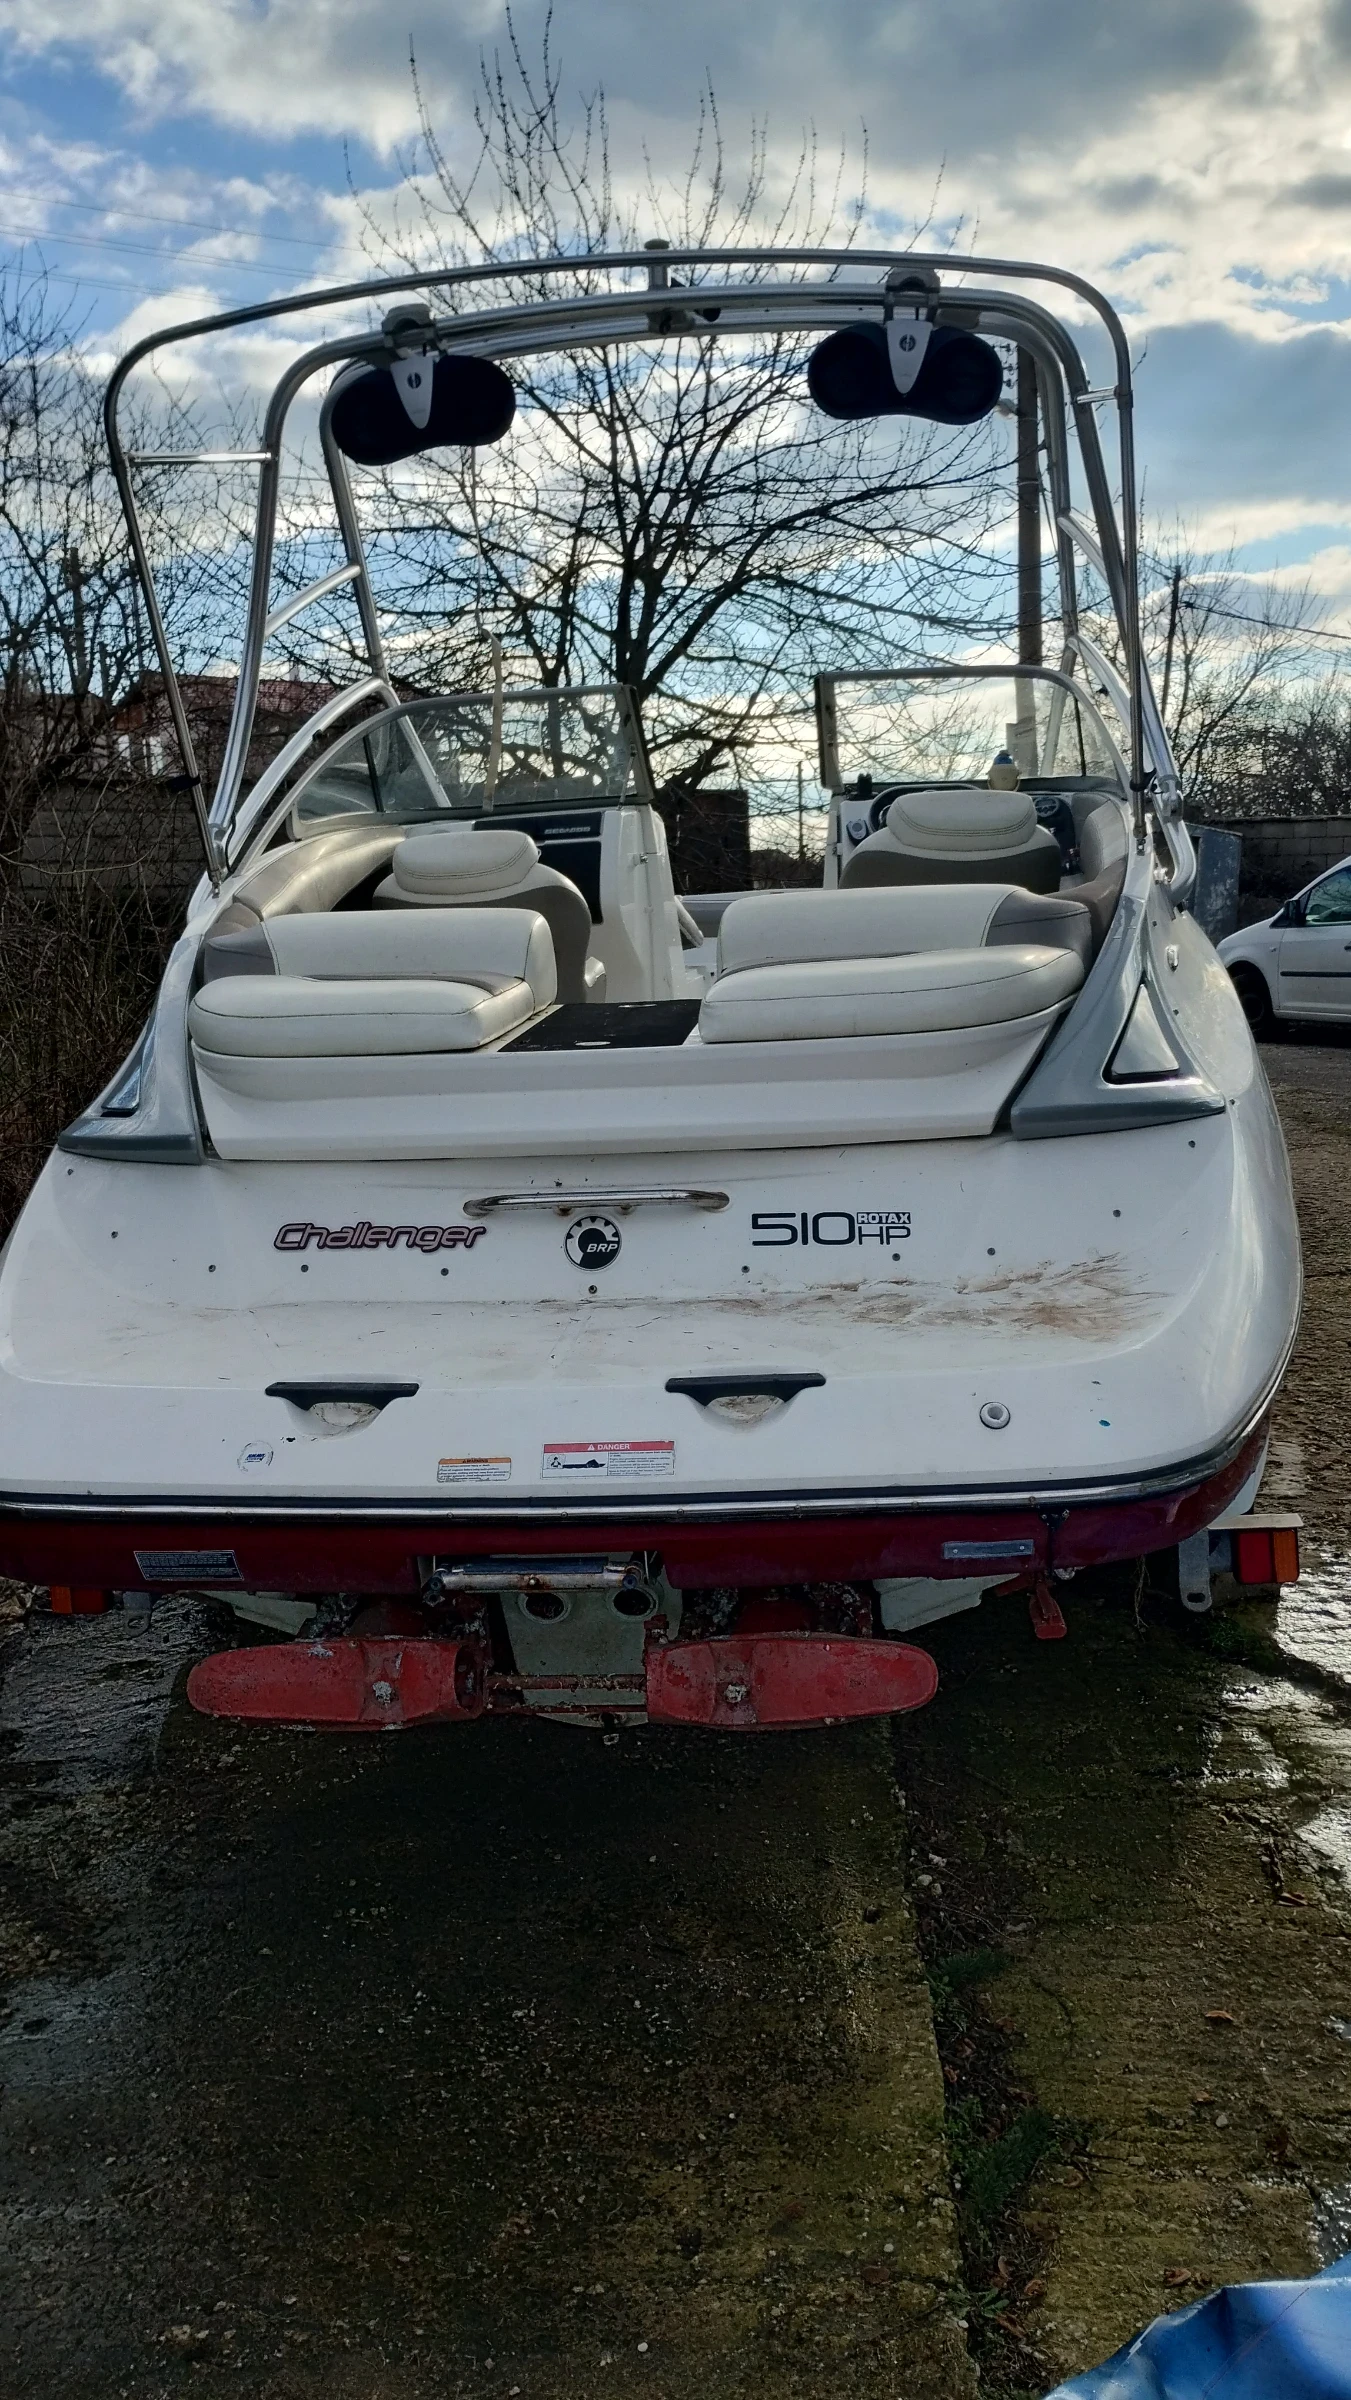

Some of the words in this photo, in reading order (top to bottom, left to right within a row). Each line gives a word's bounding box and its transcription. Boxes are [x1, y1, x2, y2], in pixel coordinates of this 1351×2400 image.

[857, 1212, 910, 1224] ROTAX
[751, 1212, 856, 1246] 510
[858, 1225, 911, 1246] HP
[274, 1222, 487, 1253] Challenger
[586, 1243, 618, 1253] BRP
[597, 1443, 631, 1451] DANGER
